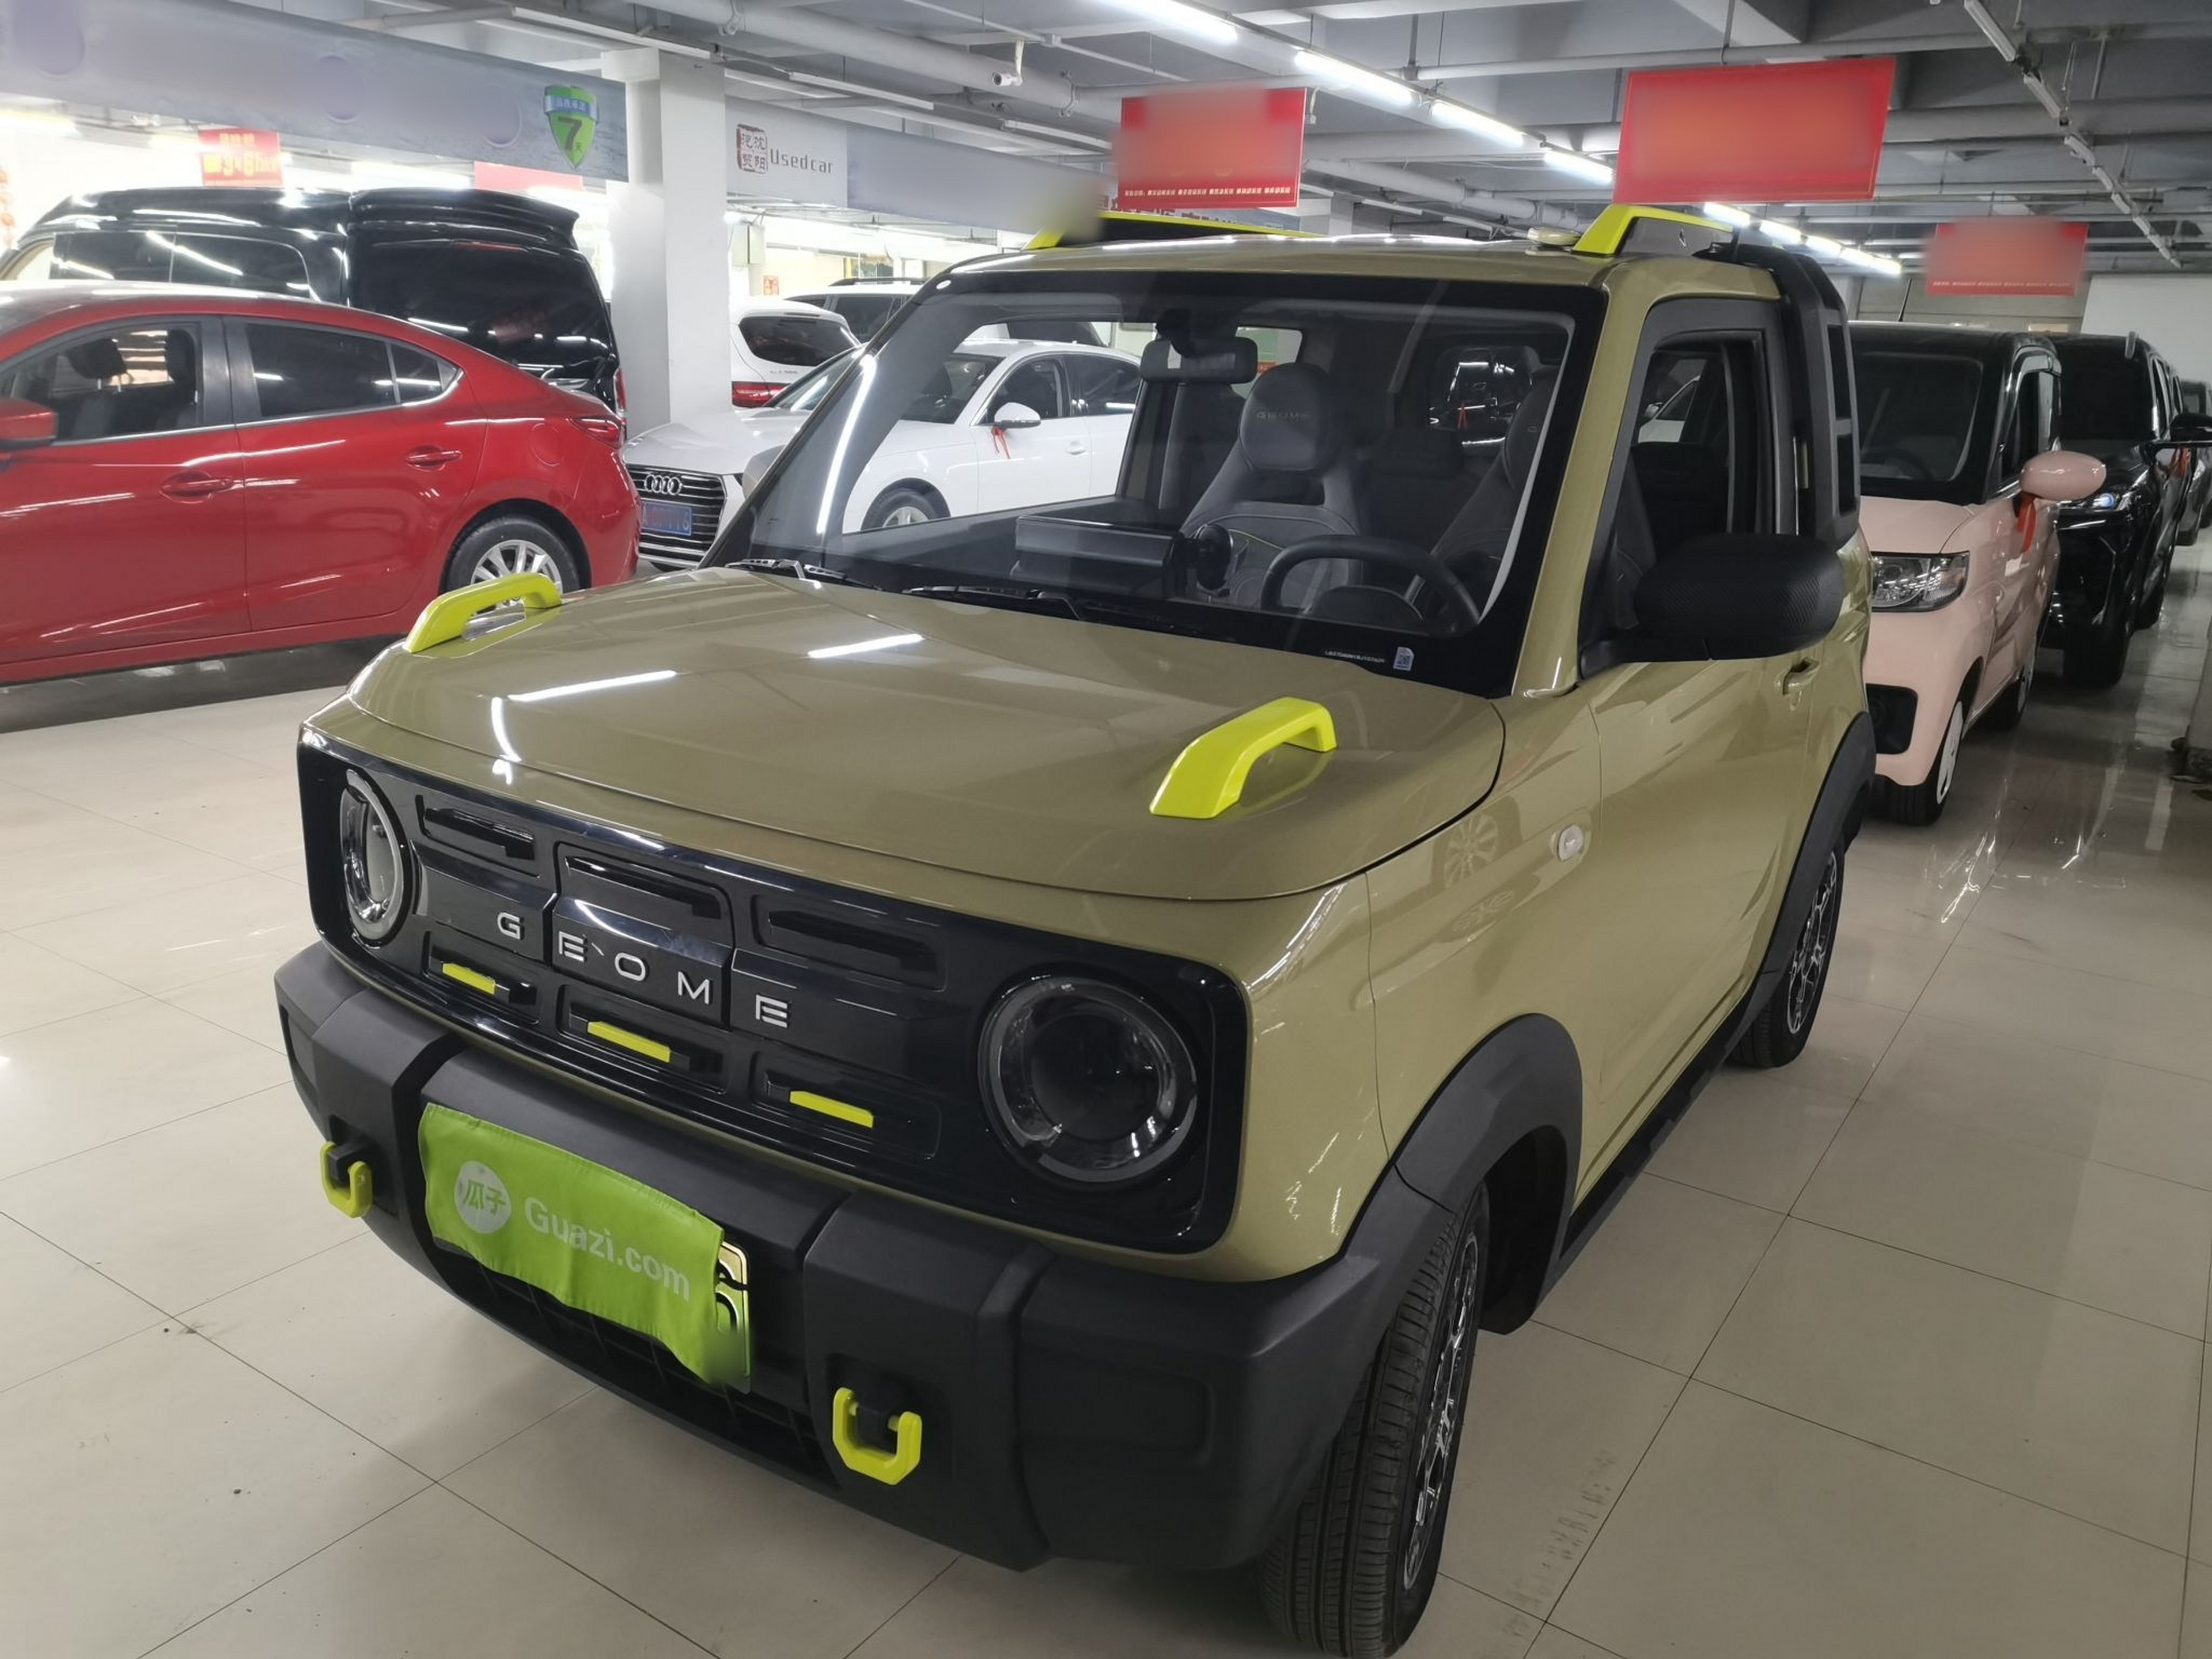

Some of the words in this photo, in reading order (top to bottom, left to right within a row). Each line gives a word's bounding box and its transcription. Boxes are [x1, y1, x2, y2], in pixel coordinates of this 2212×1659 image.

[497, 911, 789, 1028] GEOME
[463, 1179, 507, 1215] 瓜子
[525, 1196, 690, 1302] Guazi.com
